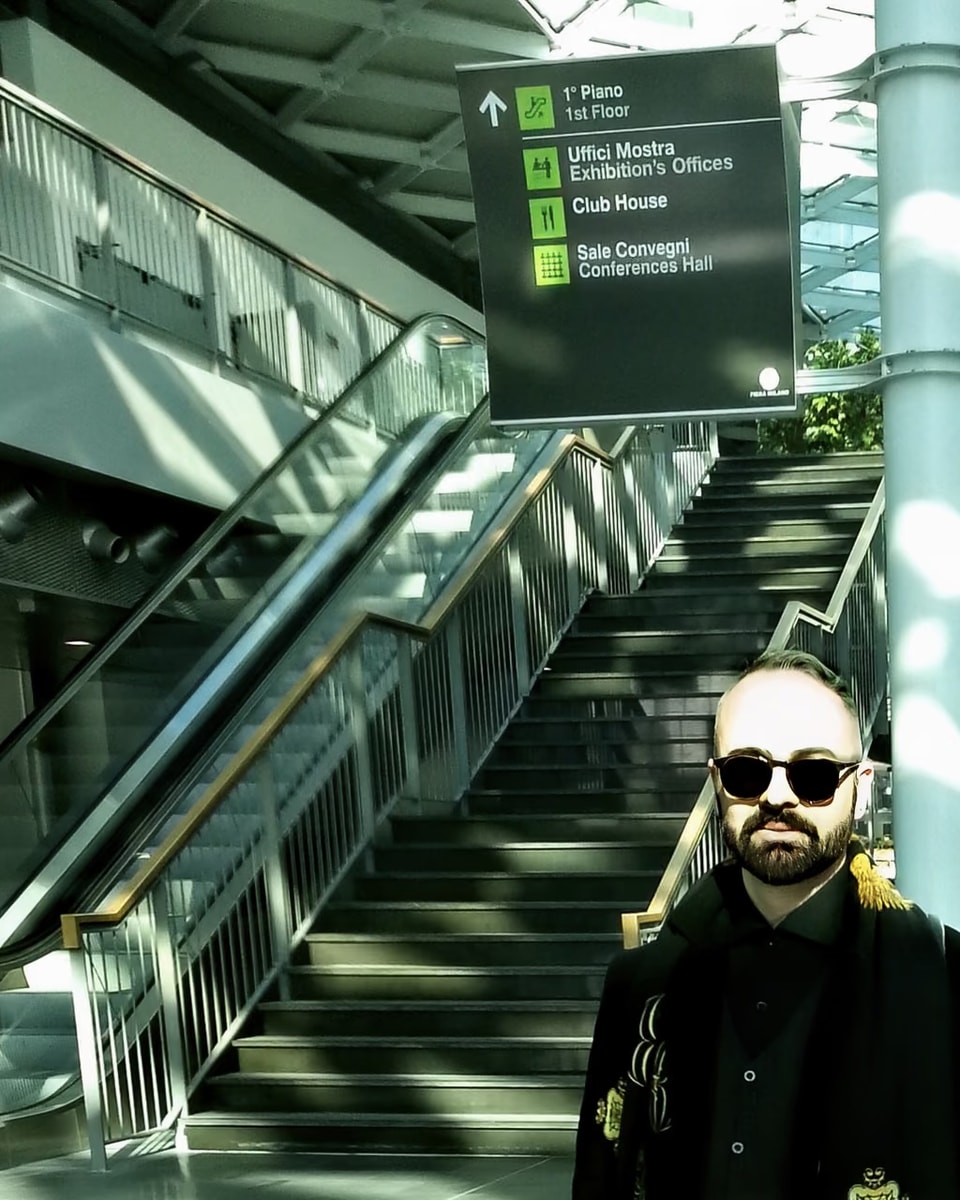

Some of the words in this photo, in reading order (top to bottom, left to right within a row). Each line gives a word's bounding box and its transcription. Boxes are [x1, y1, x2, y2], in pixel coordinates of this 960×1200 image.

[580, 84, 624, 100] Piano
[565, 106, 588, 121] 1st
[591, 103, 630, 119] Floor
[568, 144, 611, 163] Uffici
[616, 140, 675, 159] Mostra
[570, 159, 666, 182] Exhibition's
[672, 156, 733, 174] Offices
[572, 196, 610, 214] Club
[615, 194, 668, 211] House
[577, 243, 612, 260] Sale
[615, 237, 690, 258] Convegni
[578, 259, 678, 278] Conferences
[682, 255, 713, 272] Hall
